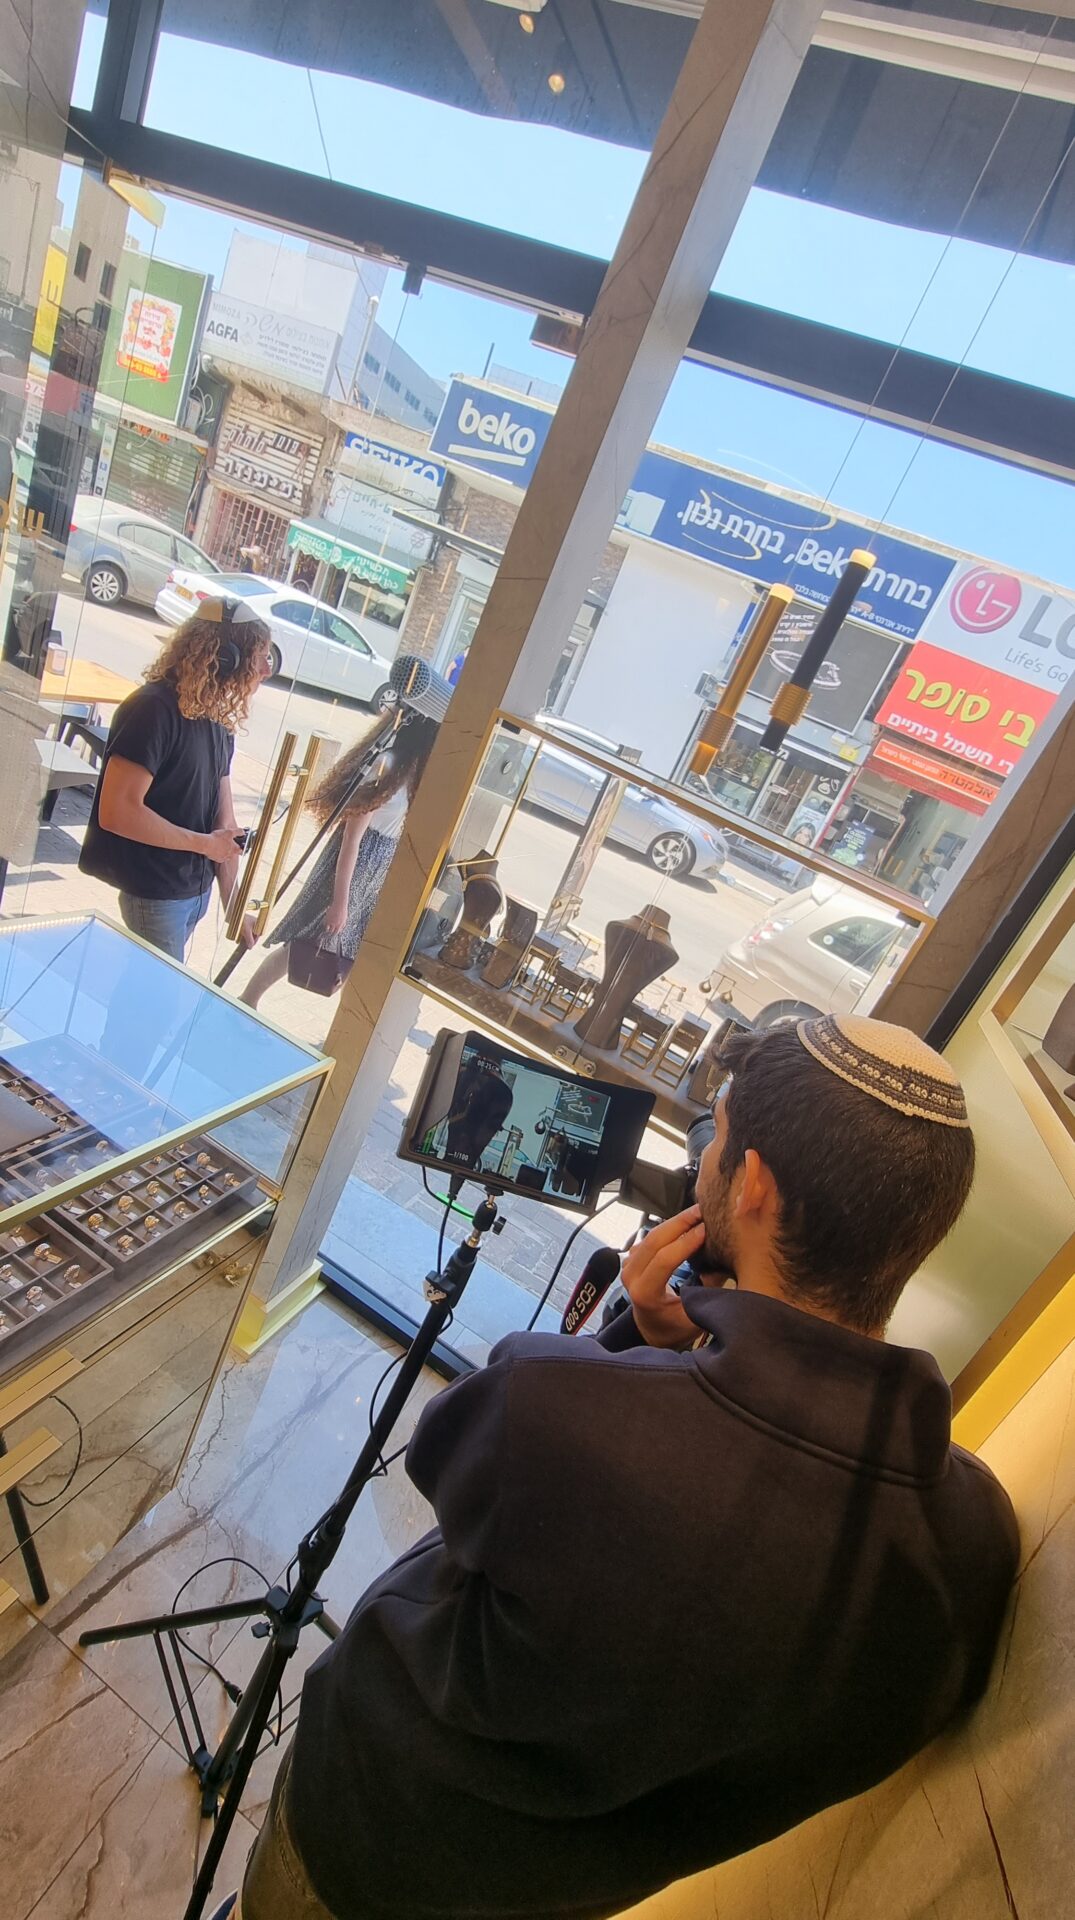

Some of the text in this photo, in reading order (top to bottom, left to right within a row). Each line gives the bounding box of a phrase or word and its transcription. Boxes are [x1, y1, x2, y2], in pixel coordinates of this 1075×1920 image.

[206, 320, 239, 342] AGFA
[458, 399, 537, 457] beko
[721, 515, 785, 555] בחרת
[783, 537, 849, 579] Bek,
[861, 567, 932, 610] בחרת
[1005, 647, 1043, 674] Life's
[905, 668, 991, 724] סופר
[887, 712, 939, 742] ביתיים
[943, 724, 994, 766] חשמל
[565, 1281, 597, 1332] EOS 90D
